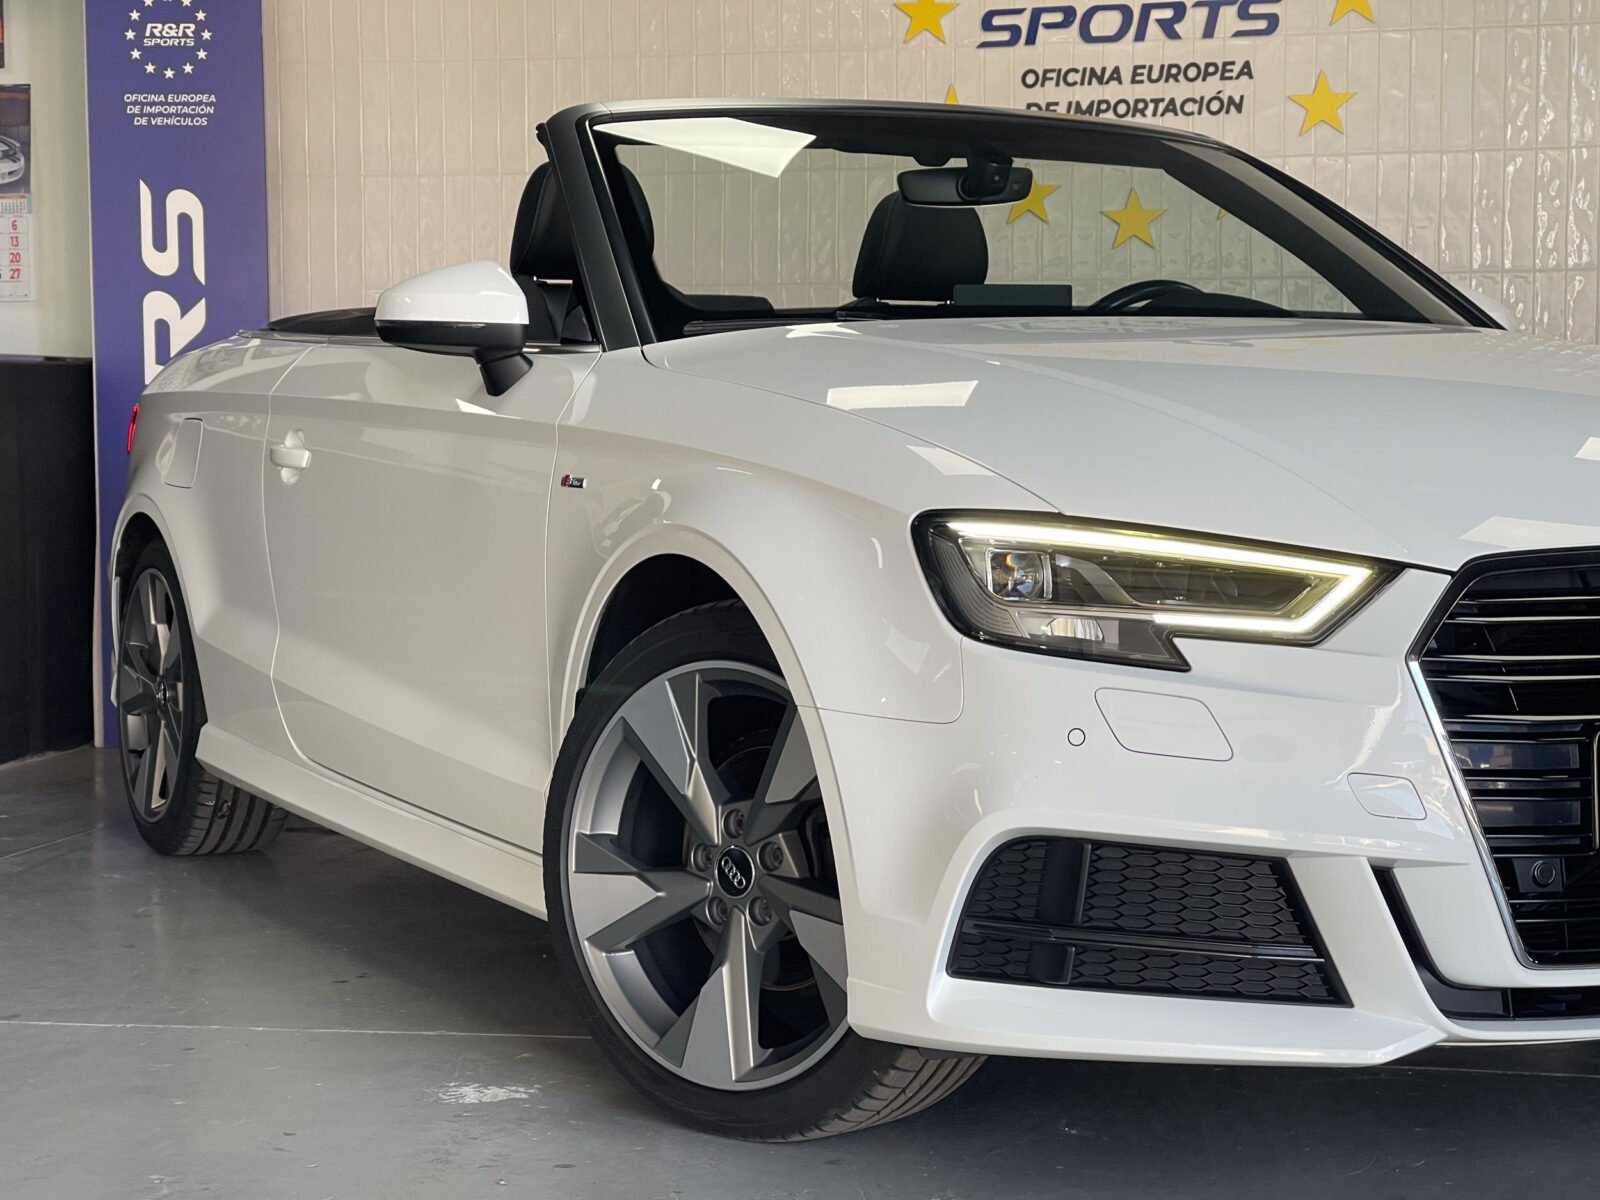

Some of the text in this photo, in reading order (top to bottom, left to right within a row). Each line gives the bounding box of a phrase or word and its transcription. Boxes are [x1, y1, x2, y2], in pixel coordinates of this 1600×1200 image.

[976, 0, 1282, 48] SPORTS
[145, 23, 196, 37] R&R
[143, 38, 195, 46] SPORTS
[1021, 60, 1254, 88] OFICINA EUROPEA
[124, 94, 216, 103] OFICINA EUROPEA
[126, 104, 215, 114] DE IMPORTACIÓN
[1066, 90, 1245, 119] IMPORTACIÓN
[134, 115, 208, 126] DE VEHÍCULOS
[11, 219, 18, 231] 6
[10, 236, 19, 247] 13
[9, 252, 21, 263] 20
[9, 268, 21, 279] 27
